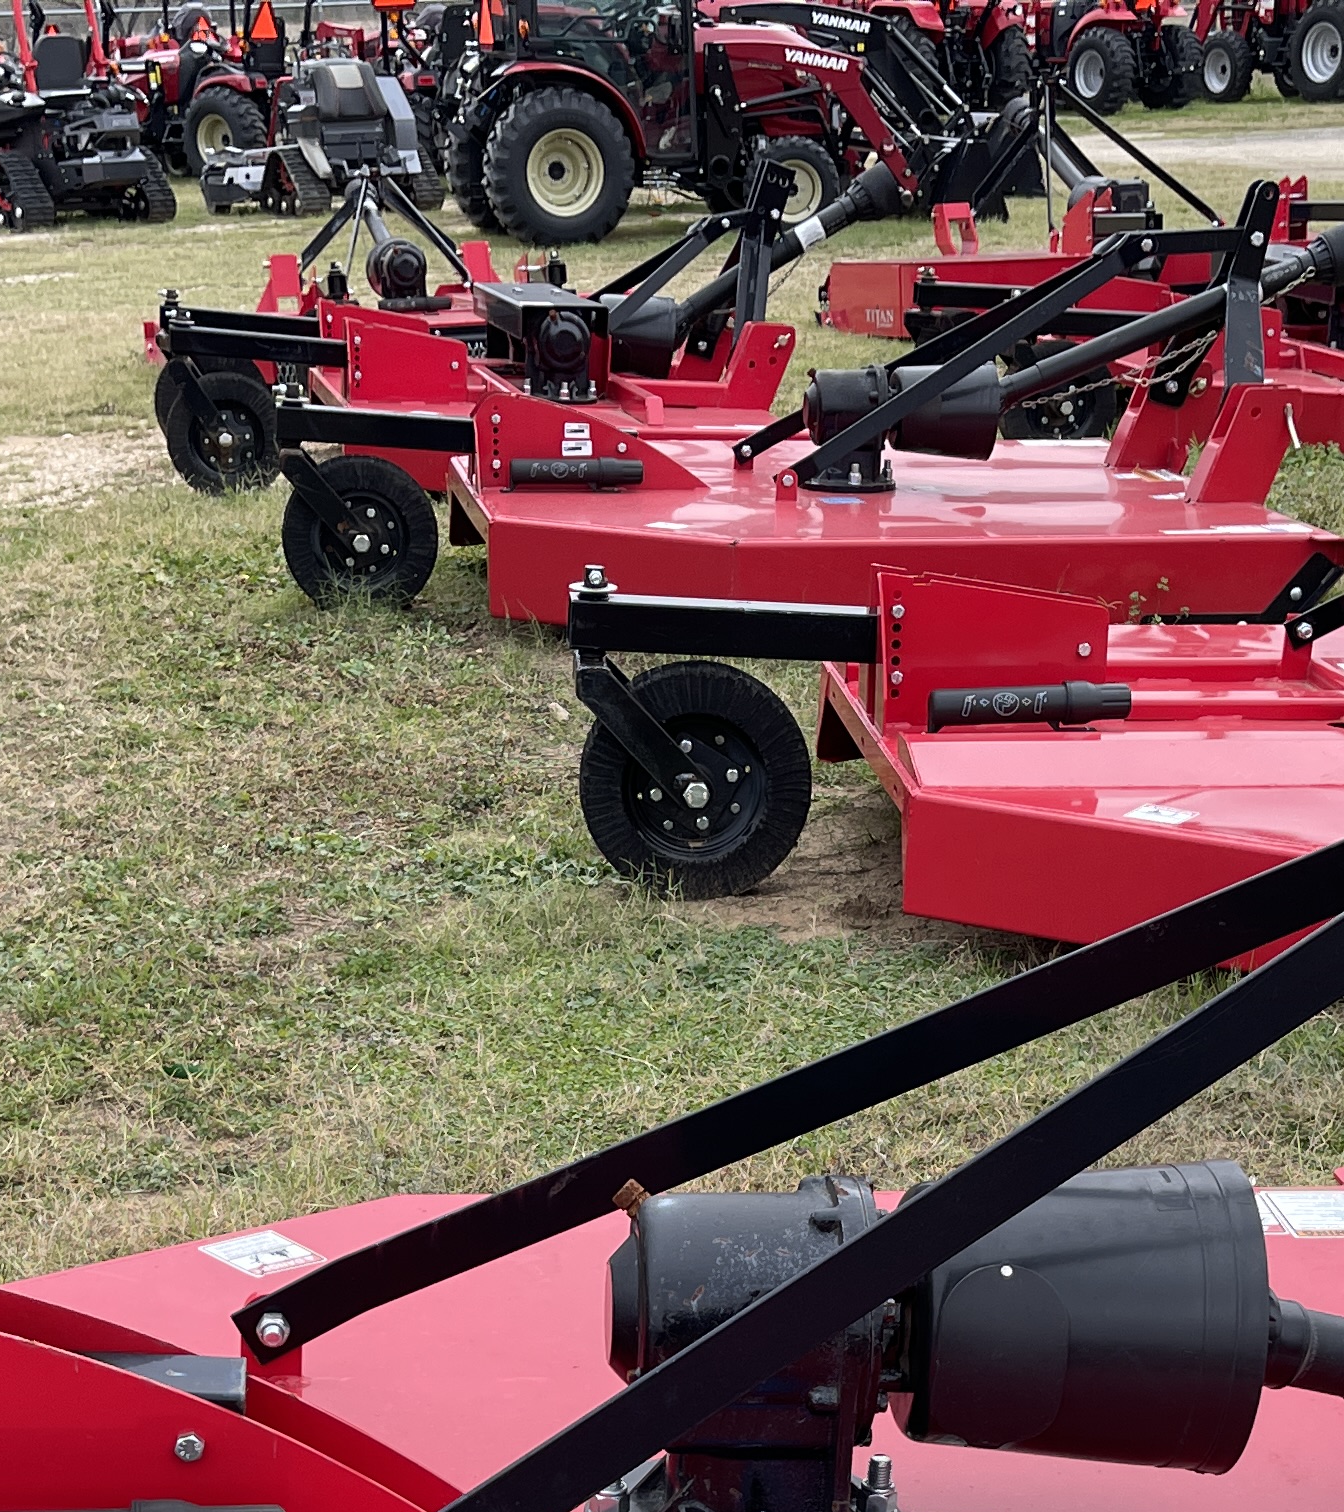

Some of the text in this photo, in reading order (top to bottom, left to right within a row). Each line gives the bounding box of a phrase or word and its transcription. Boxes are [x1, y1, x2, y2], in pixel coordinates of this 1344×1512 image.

[811, 11, 871, 34] YANMAR
[785, 48, 849, 72] YANMAR
[865, 305, 894, 329] TITAN
